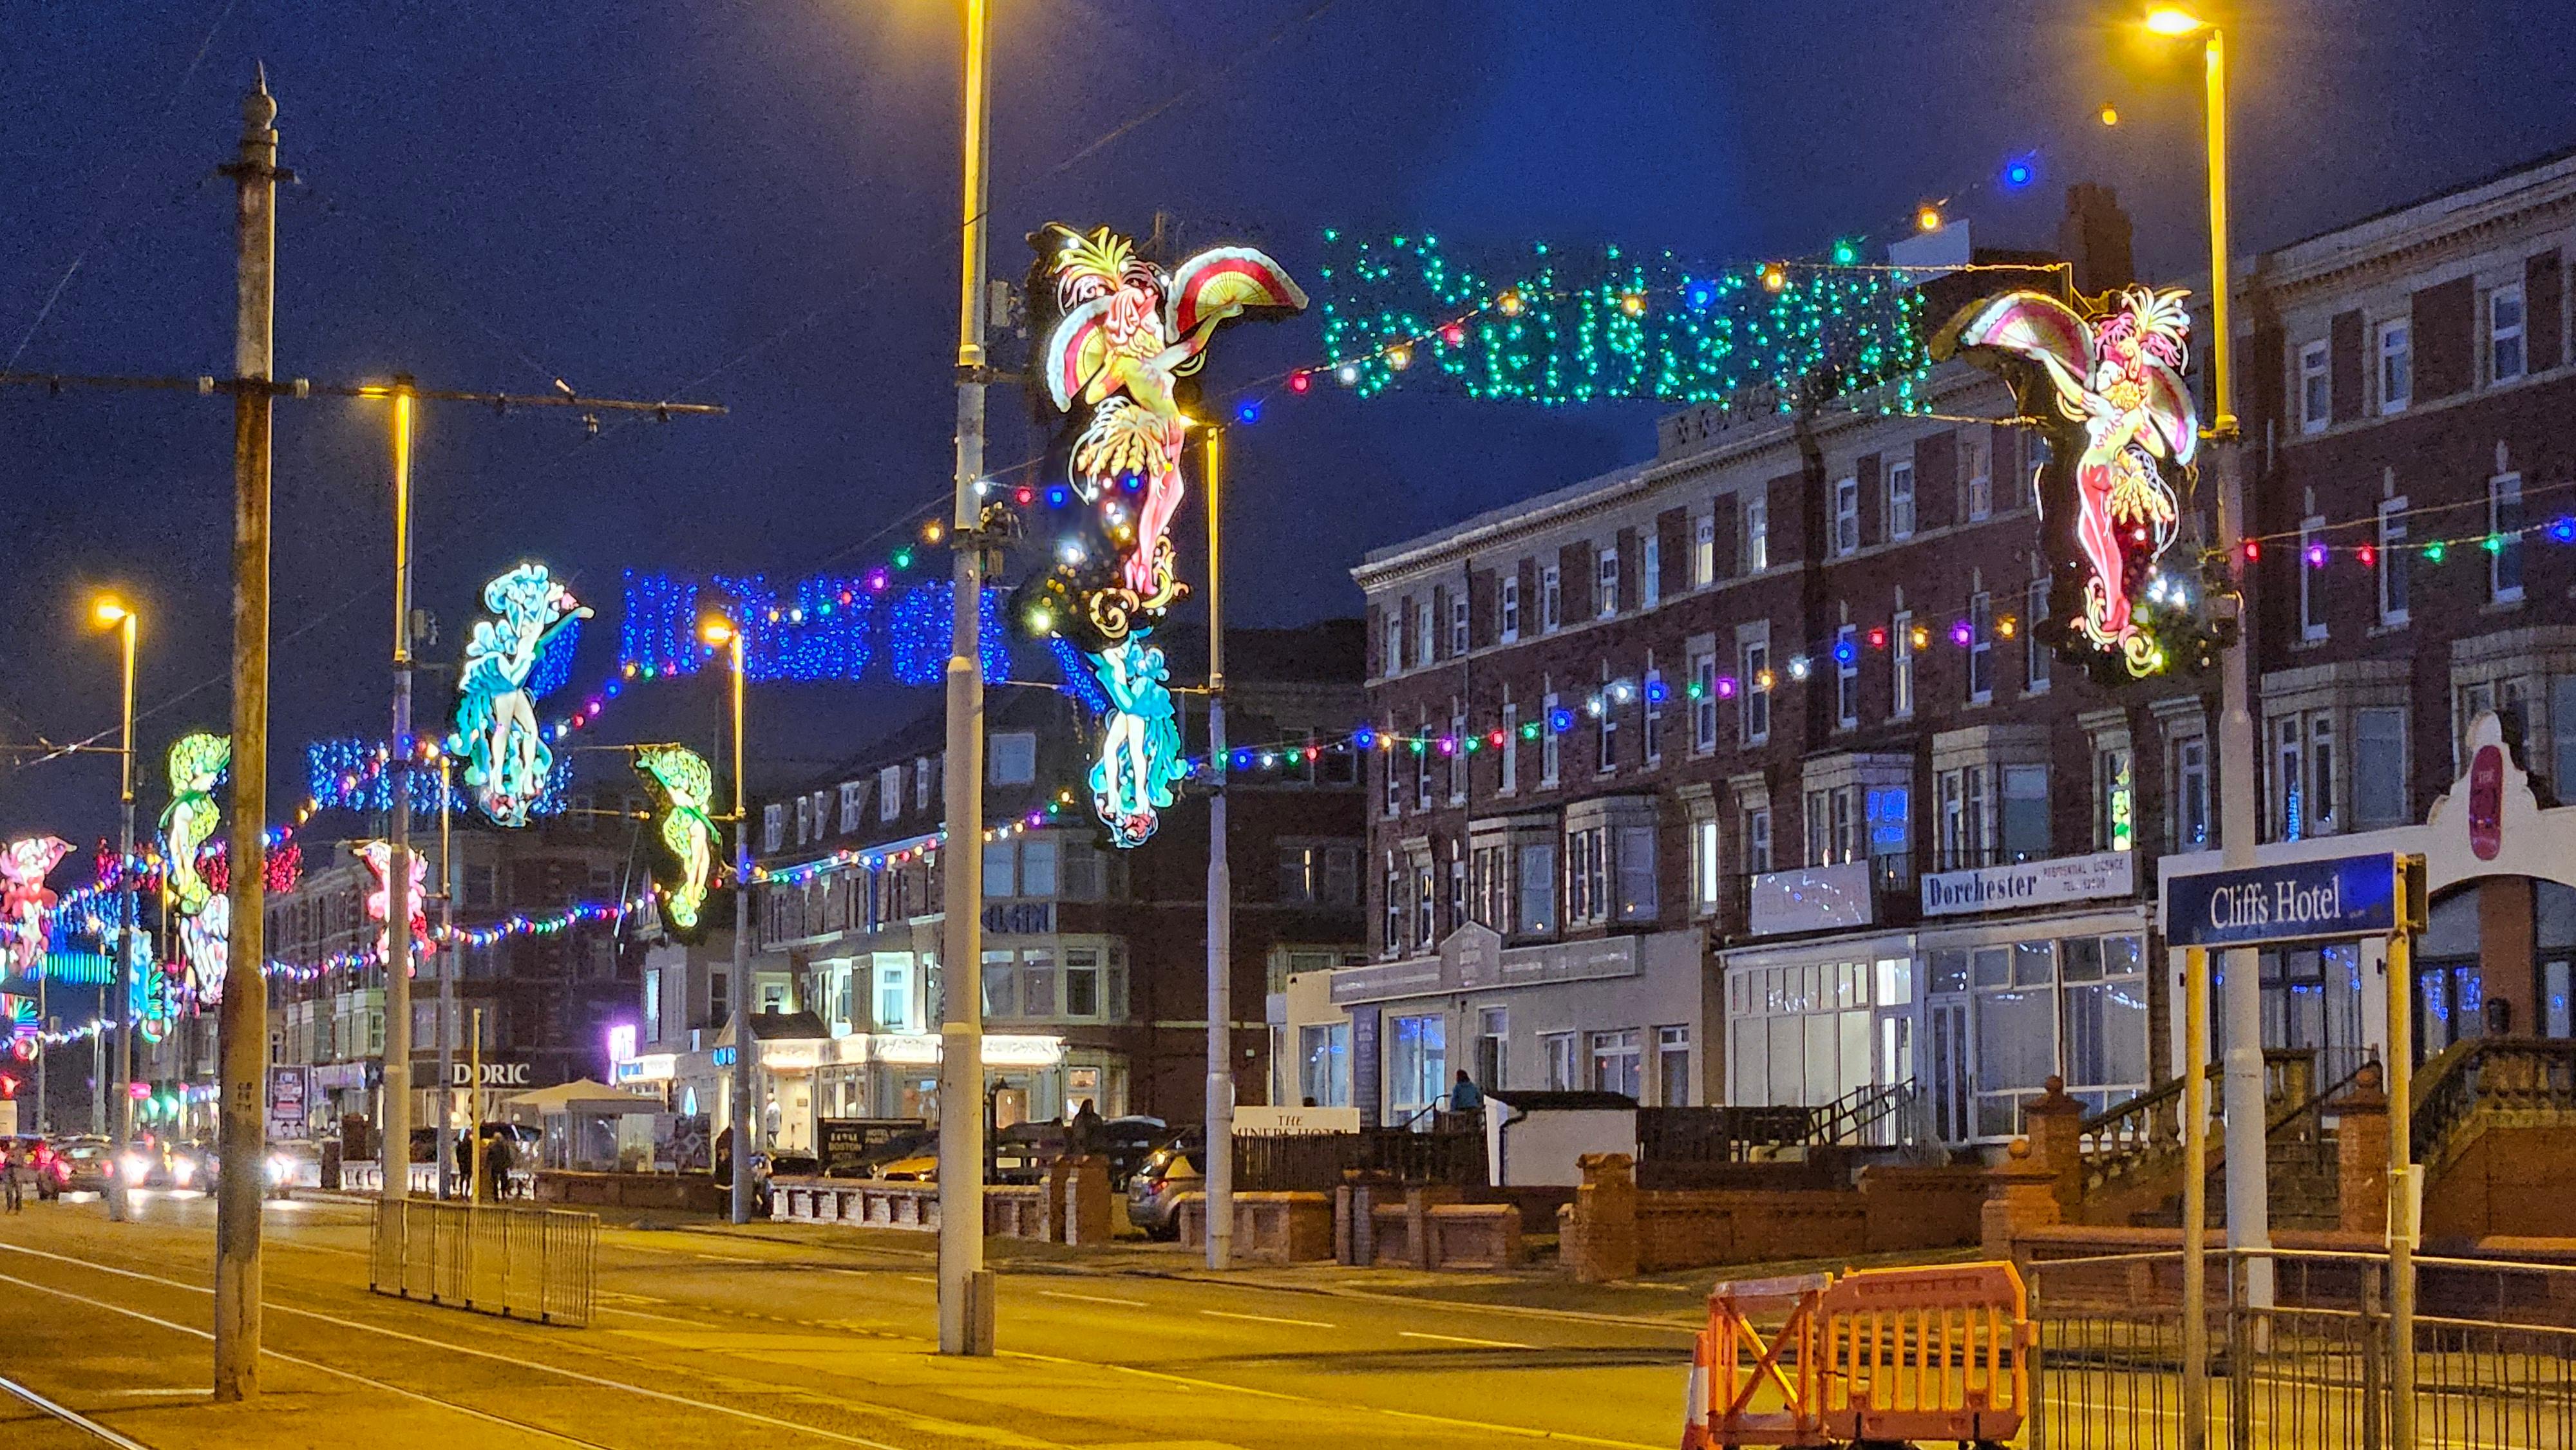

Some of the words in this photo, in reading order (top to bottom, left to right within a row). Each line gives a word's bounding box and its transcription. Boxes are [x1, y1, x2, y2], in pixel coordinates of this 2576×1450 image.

[1929, 872, 2037, 907] Dorchester
[2210, 882, 2269, 929] Cliffs
[2275, 874, 2342, 923] Hotel
[453, 1063, 530, 1084] DORIC
[1278, 1115, 1304, 1126] THE
[828, 1142, 862, 1151] BOSTON
